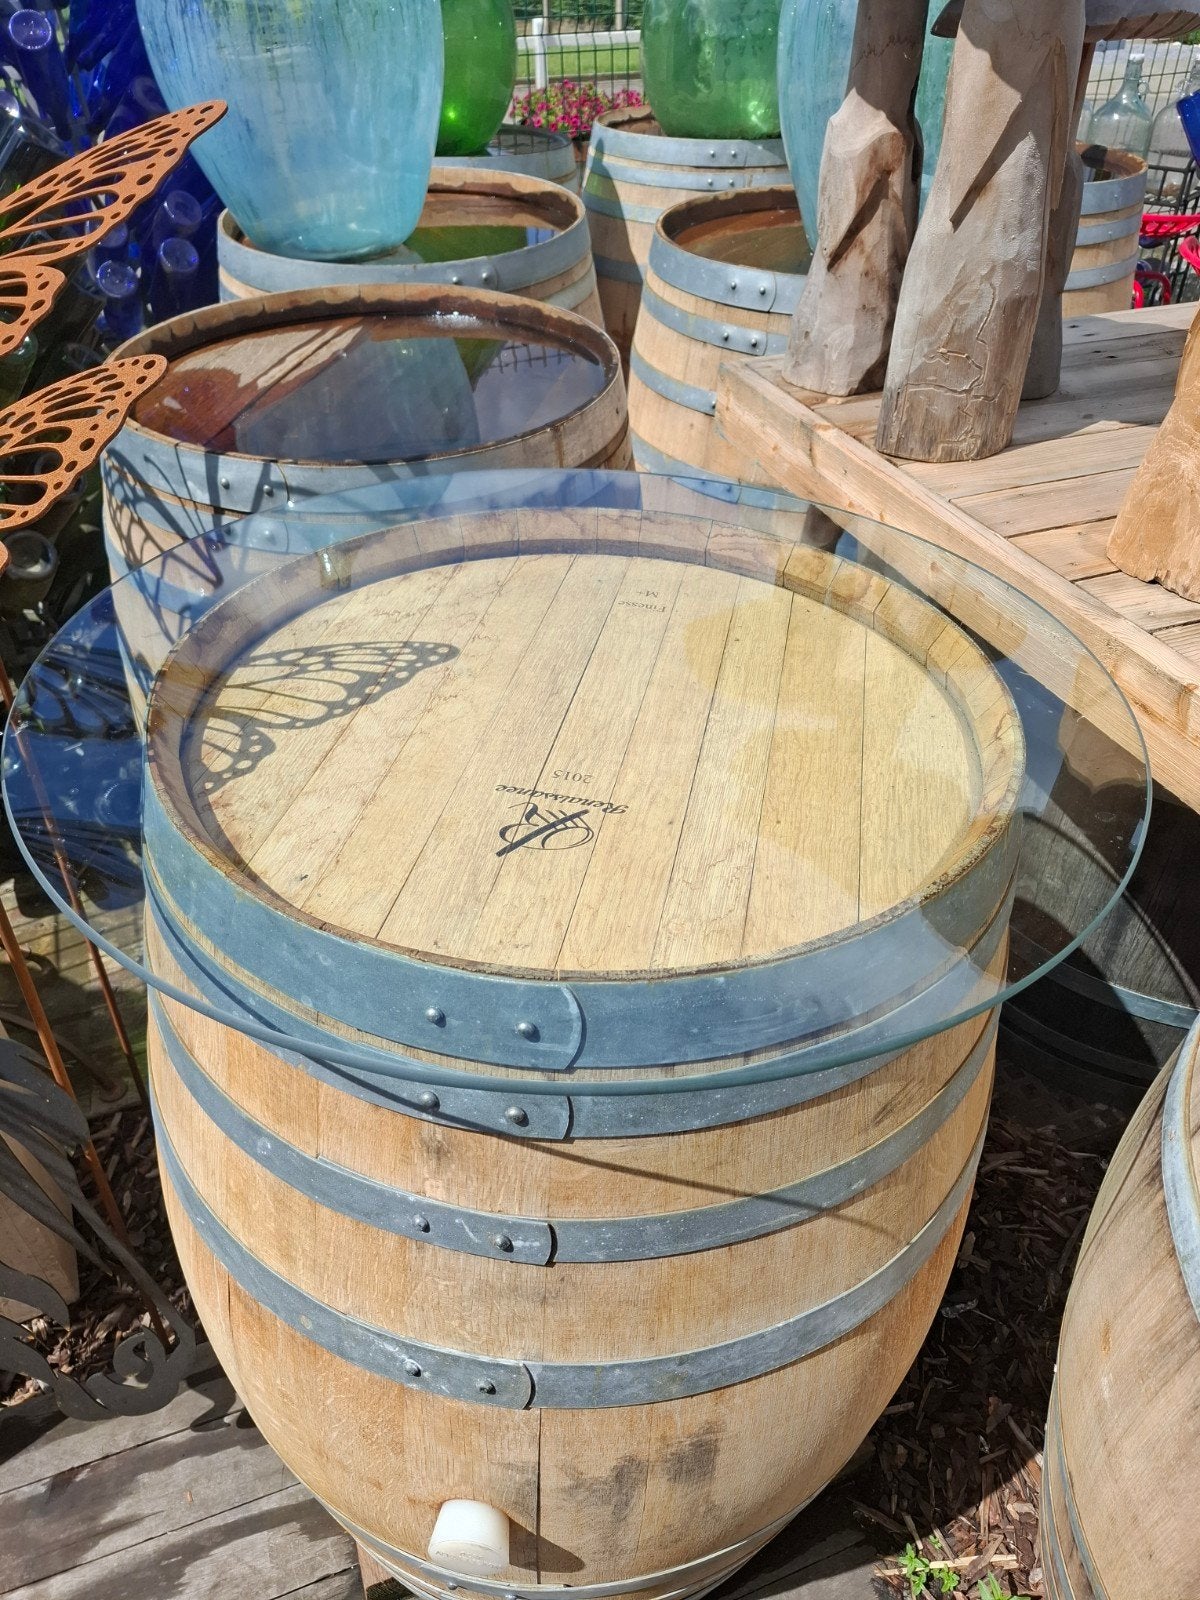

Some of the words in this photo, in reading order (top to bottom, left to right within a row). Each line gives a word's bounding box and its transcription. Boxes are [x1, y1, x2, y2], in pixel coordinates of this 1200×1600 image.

[617, 600, 666, 612] Finesse
[553, 769, 594, 784] 2015
[495, 784, 629, 814] Renaissance
